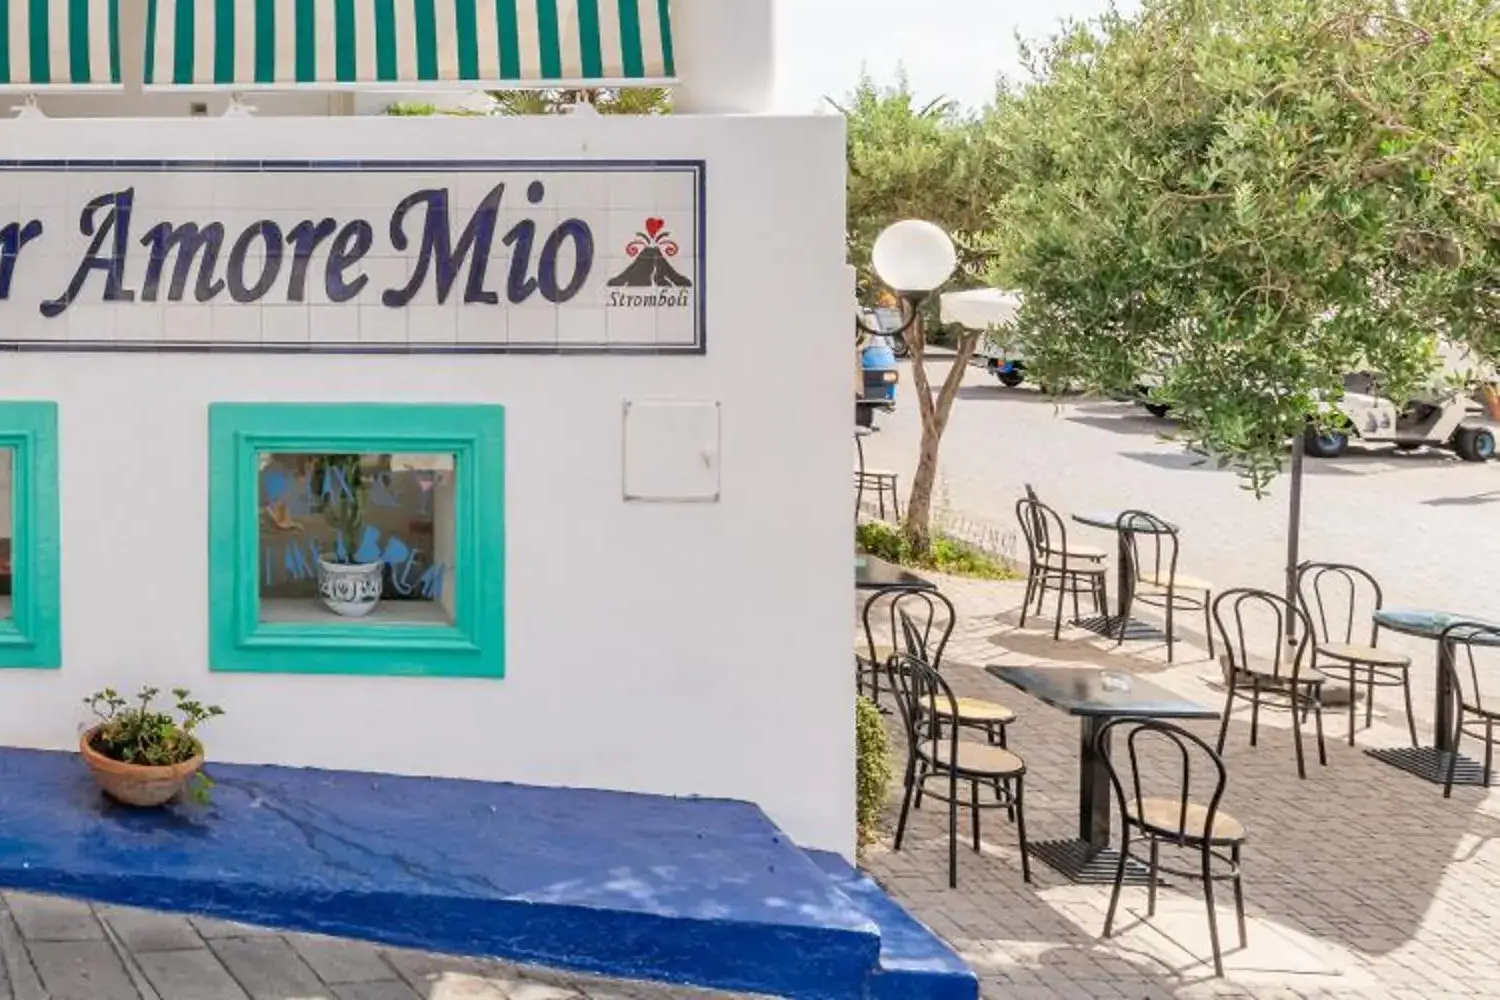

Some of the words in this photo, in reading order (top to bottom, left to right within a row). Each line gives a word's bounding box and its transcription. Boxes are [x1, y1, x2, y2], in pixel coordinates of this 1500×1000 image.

[39, 186, 374, 318] Amore
[381, 180, 595, 308] Mio
[609, 288, 690, 308] Stromboli
